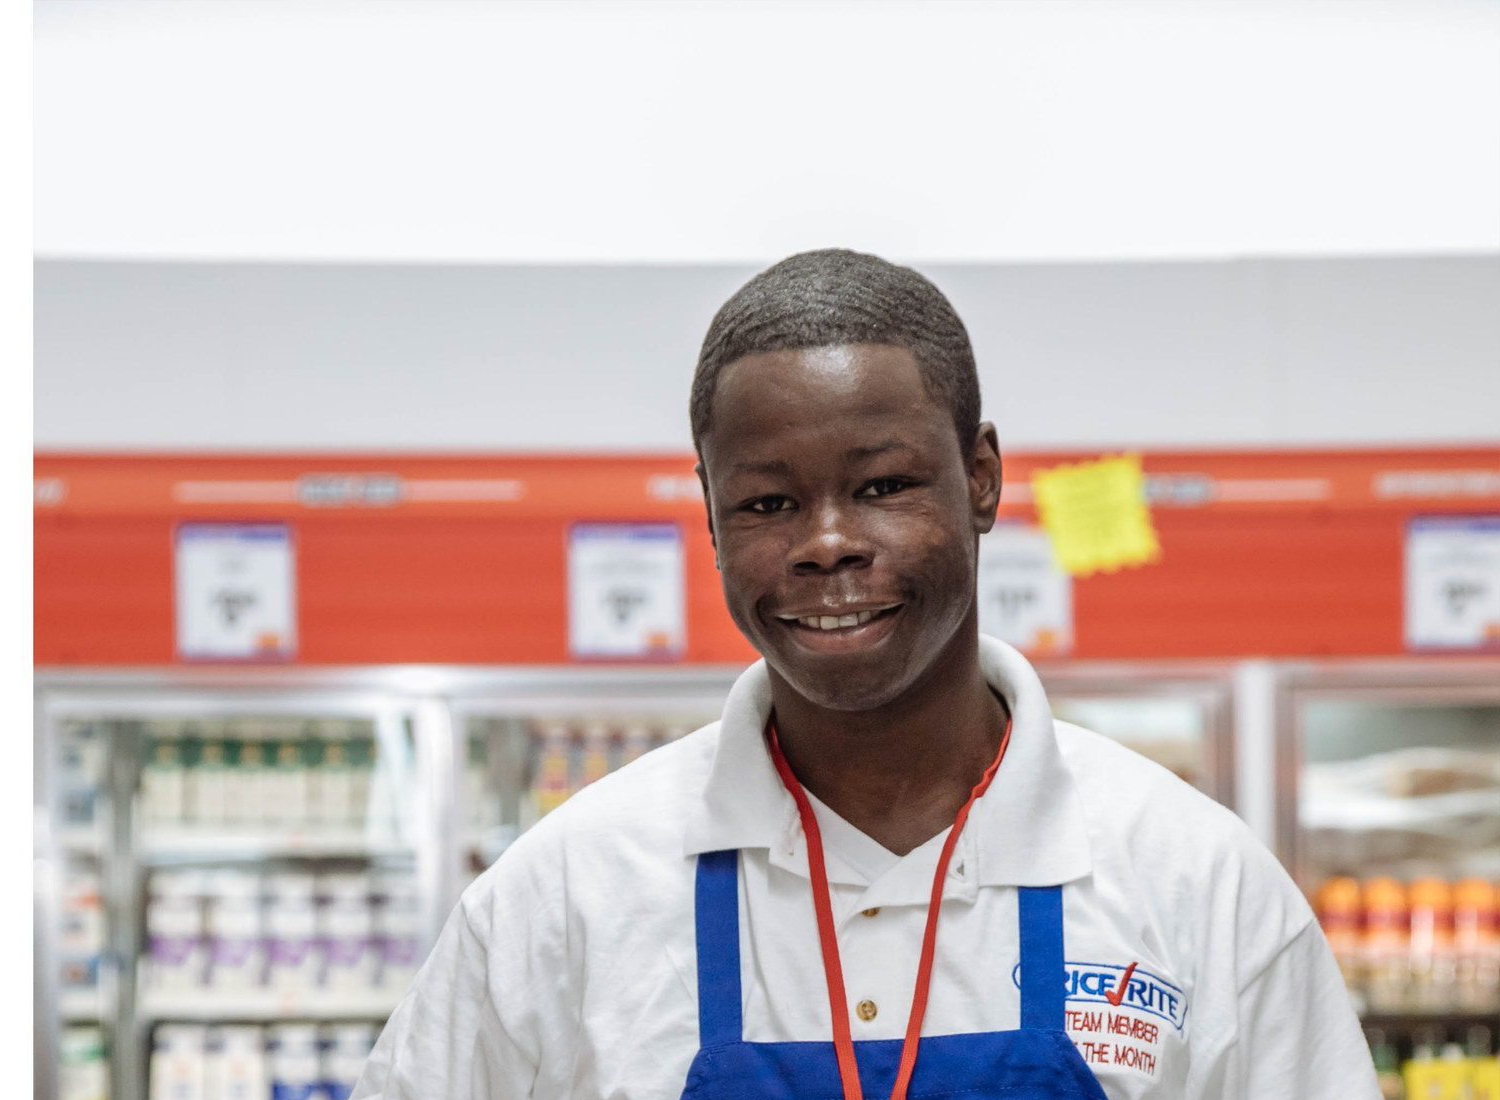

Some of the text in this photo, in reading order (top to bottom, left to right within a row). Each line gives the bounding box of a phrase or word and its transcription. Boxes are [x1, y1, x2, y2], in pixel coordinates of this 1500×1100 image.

[1065, 1011, 1159, 1045] TEAM MEMBER
[1082, 1042, 1156, 1076] THE MONTH
